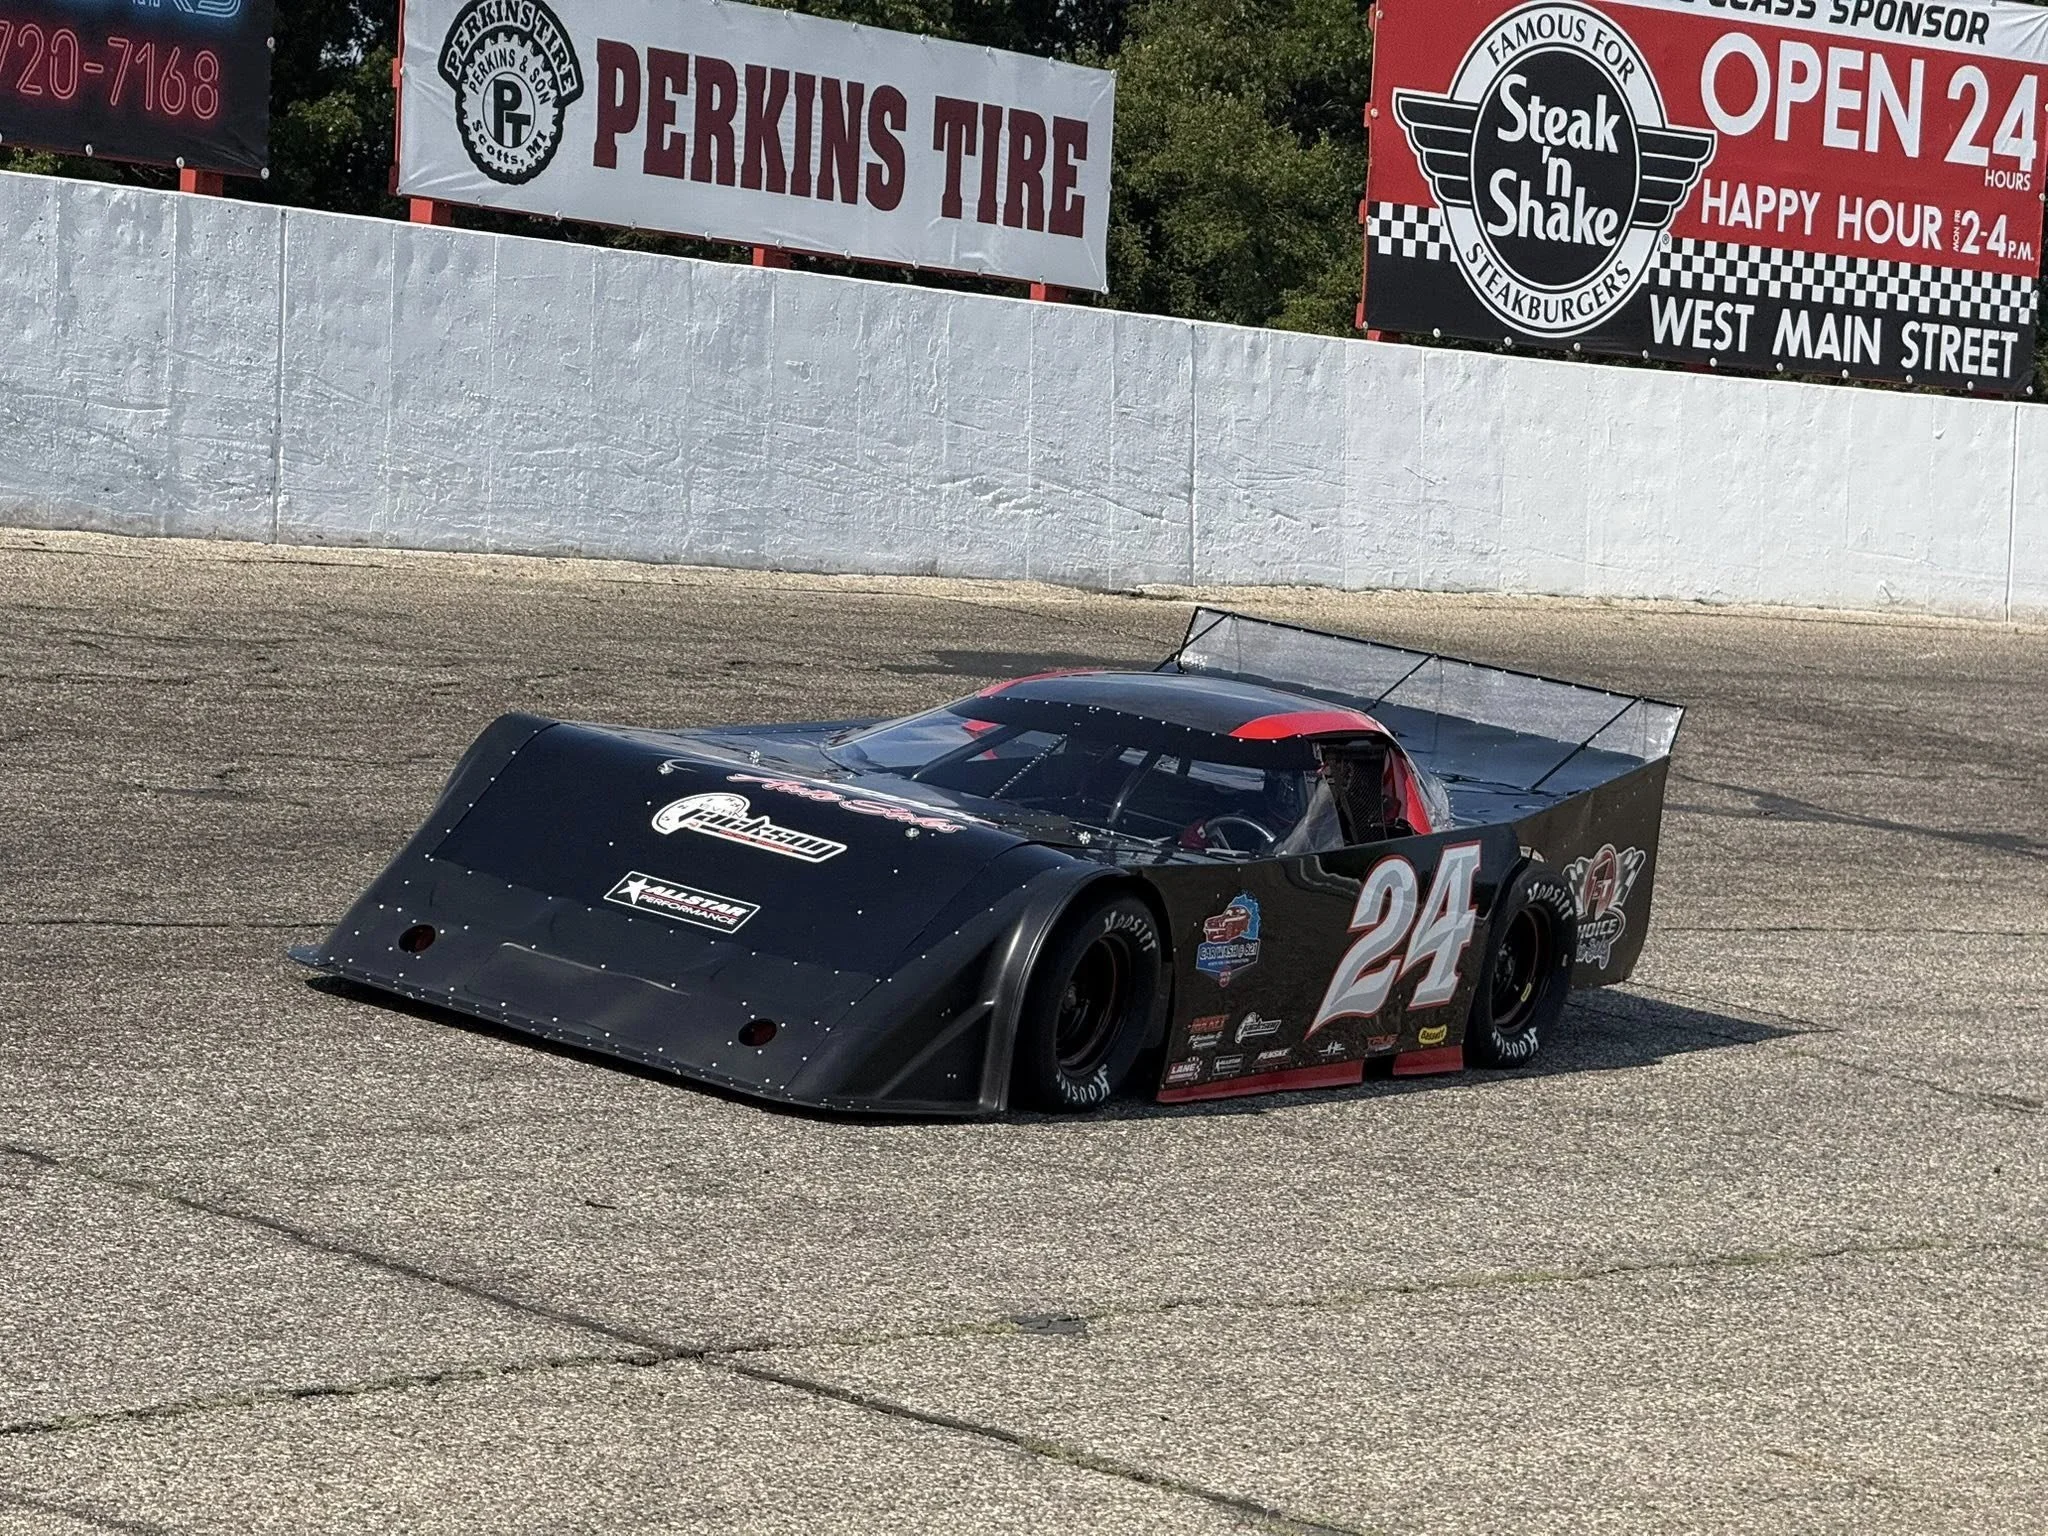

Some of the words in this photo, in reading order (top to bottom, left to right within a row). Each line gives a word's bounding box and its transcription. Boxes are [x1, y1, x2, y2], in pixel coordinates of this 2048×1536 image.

[446, 0, 534, 77] PERKINS
[535, 13, 576, 94] TIRE
[1487, 14, 1587, 67] FAMOUS
[1592, 29, 1636, 85] FOR
[1829, 0, 1990, 45] SPONSOR
[469, 48, 516, 95] PERKINS
[519, 56, 529, 73] &
[529, 68, 551, 105] SON
[1701, 32, 1925, 158] OPEN
[1944, 65, 2038, 171] 24
[472, 120, 525, 166] Scotts,
[526, 130, 549, 158] MI
[593, 38, 907, 212] PERKINS
[932, 95, 1088, 238] TIRE
[1497, 73, 1621, 154] Steak
[1541, 146, 1573, 198] 'n
[1985, 168, 2032, 191] HOURS
[1487, 168, 1619, 247] Shake
[1701, 178, 1821, 236] HAPPY
[1837, 195, 1942, 250] HOUR
[1960, 209, 2007, 258] 2-4
[2007, 240, 2035, 261] P.M.
[1466, 243, 1632, 324] STEAKBURGERS
[1650, 294, 1754, 352] WEST
[1772, 308, 1881, 365] MAIN
[1901, 320, 2018, 378] STREET
[638, 894, 738, 925] PERFORMANCE
[644, 885, 748, 917] ALLSTAR
[1576, 918, 1618, 939] HOICE
[1304, 840, 1482, 1041] 24
[1171, 1063, 1196, 1075] LANE
